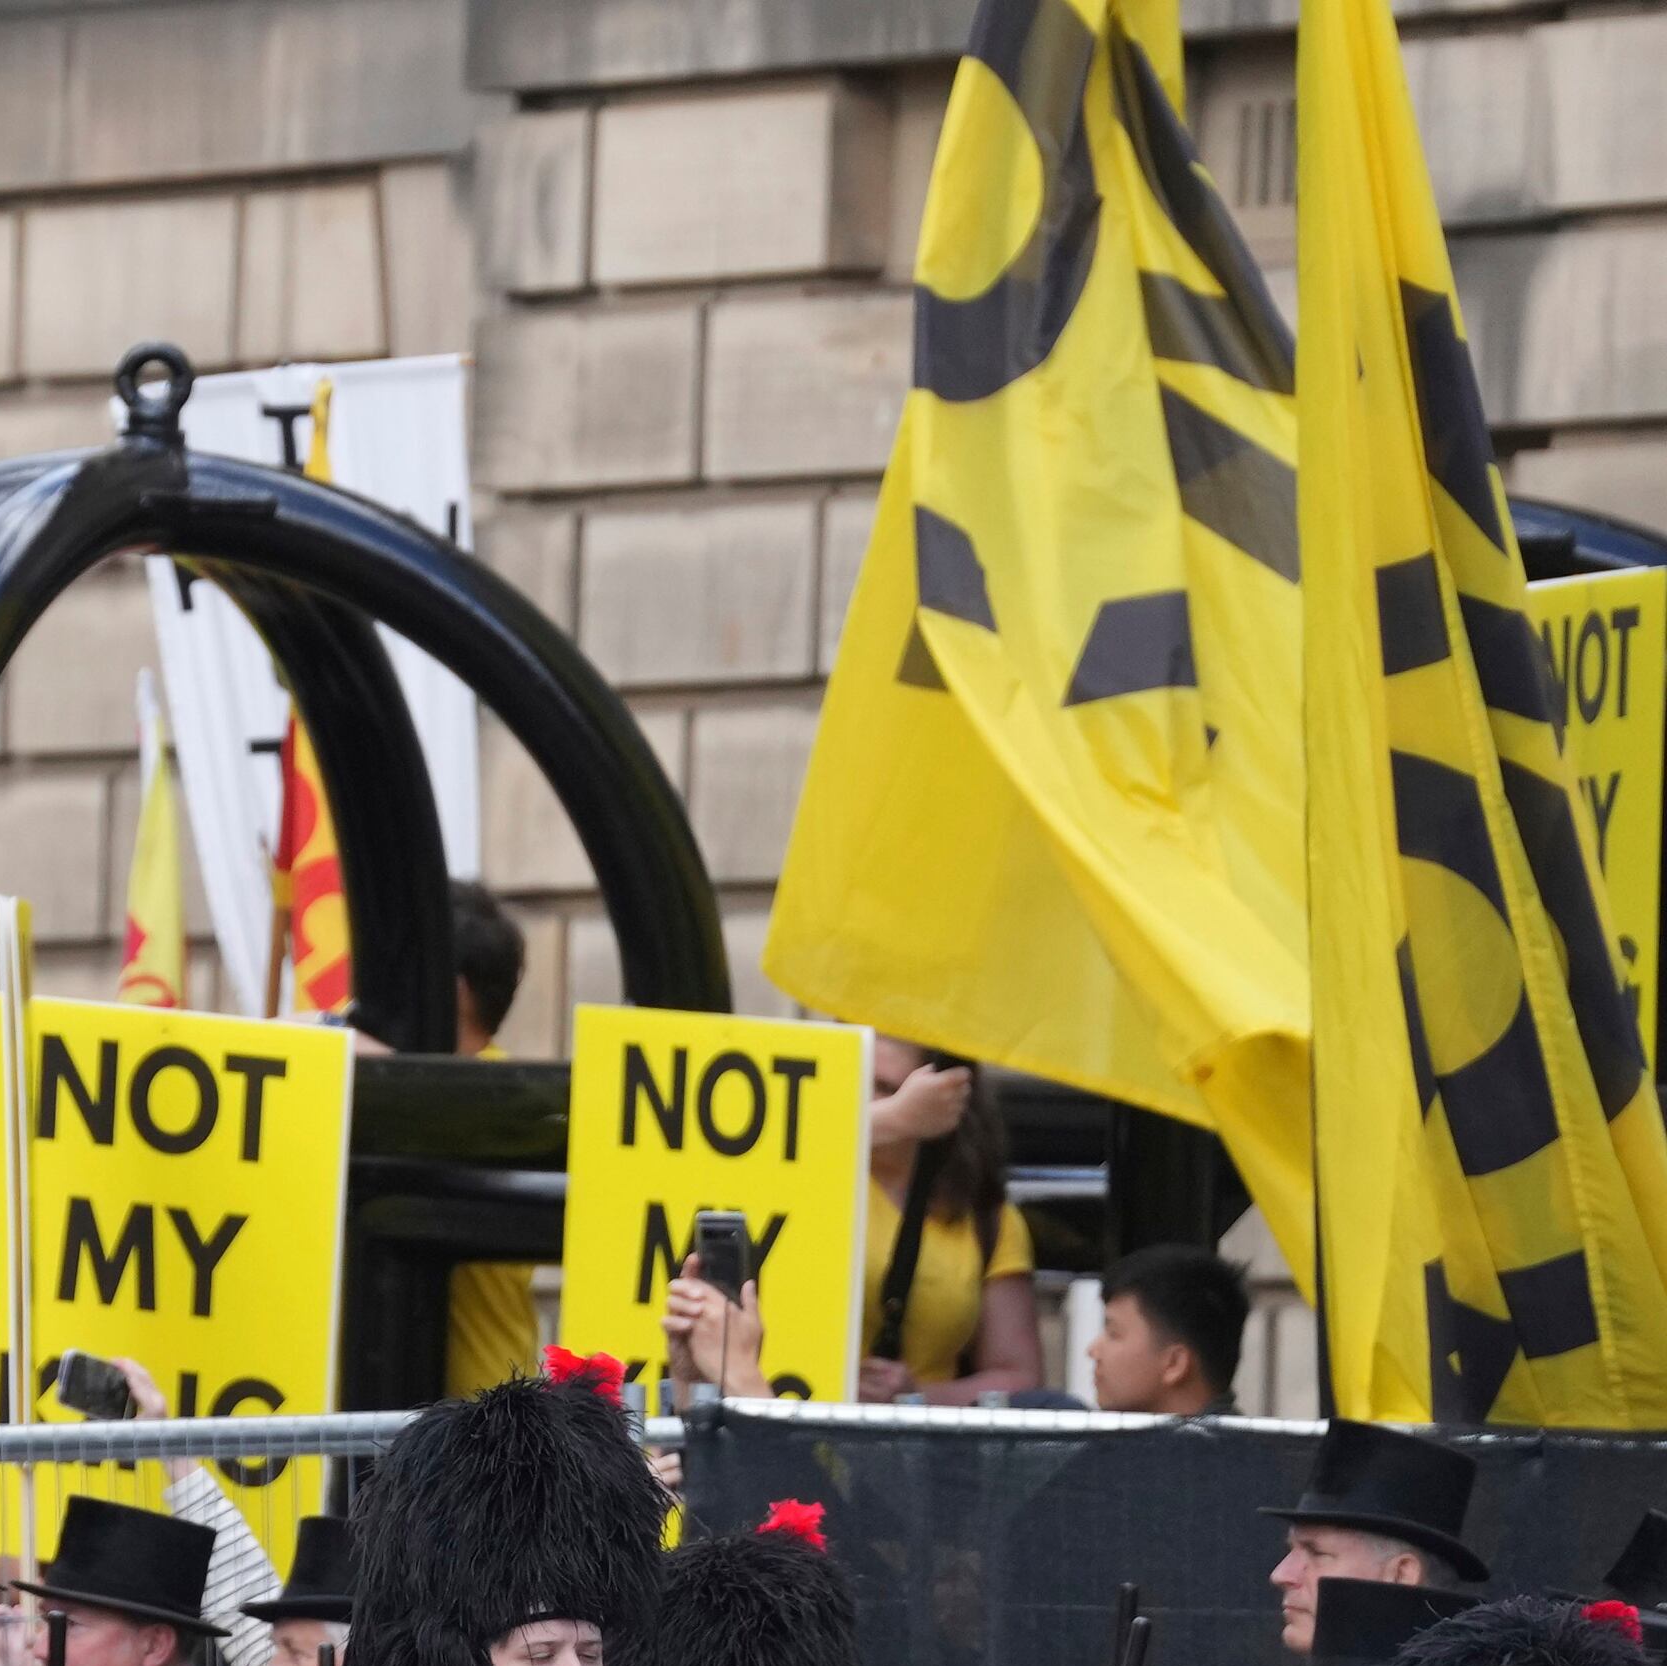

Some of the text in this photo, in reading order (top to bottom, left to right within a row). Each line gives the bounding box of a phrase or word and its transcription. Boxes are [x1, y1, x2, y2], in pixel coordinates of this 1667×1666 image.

[1579, 770, 1622, 882] Y
[37, 1032, 287, 1163] NOT
[621, 1042, 817, 1161] NOT
[57, 1197, 248, 1317] MY
